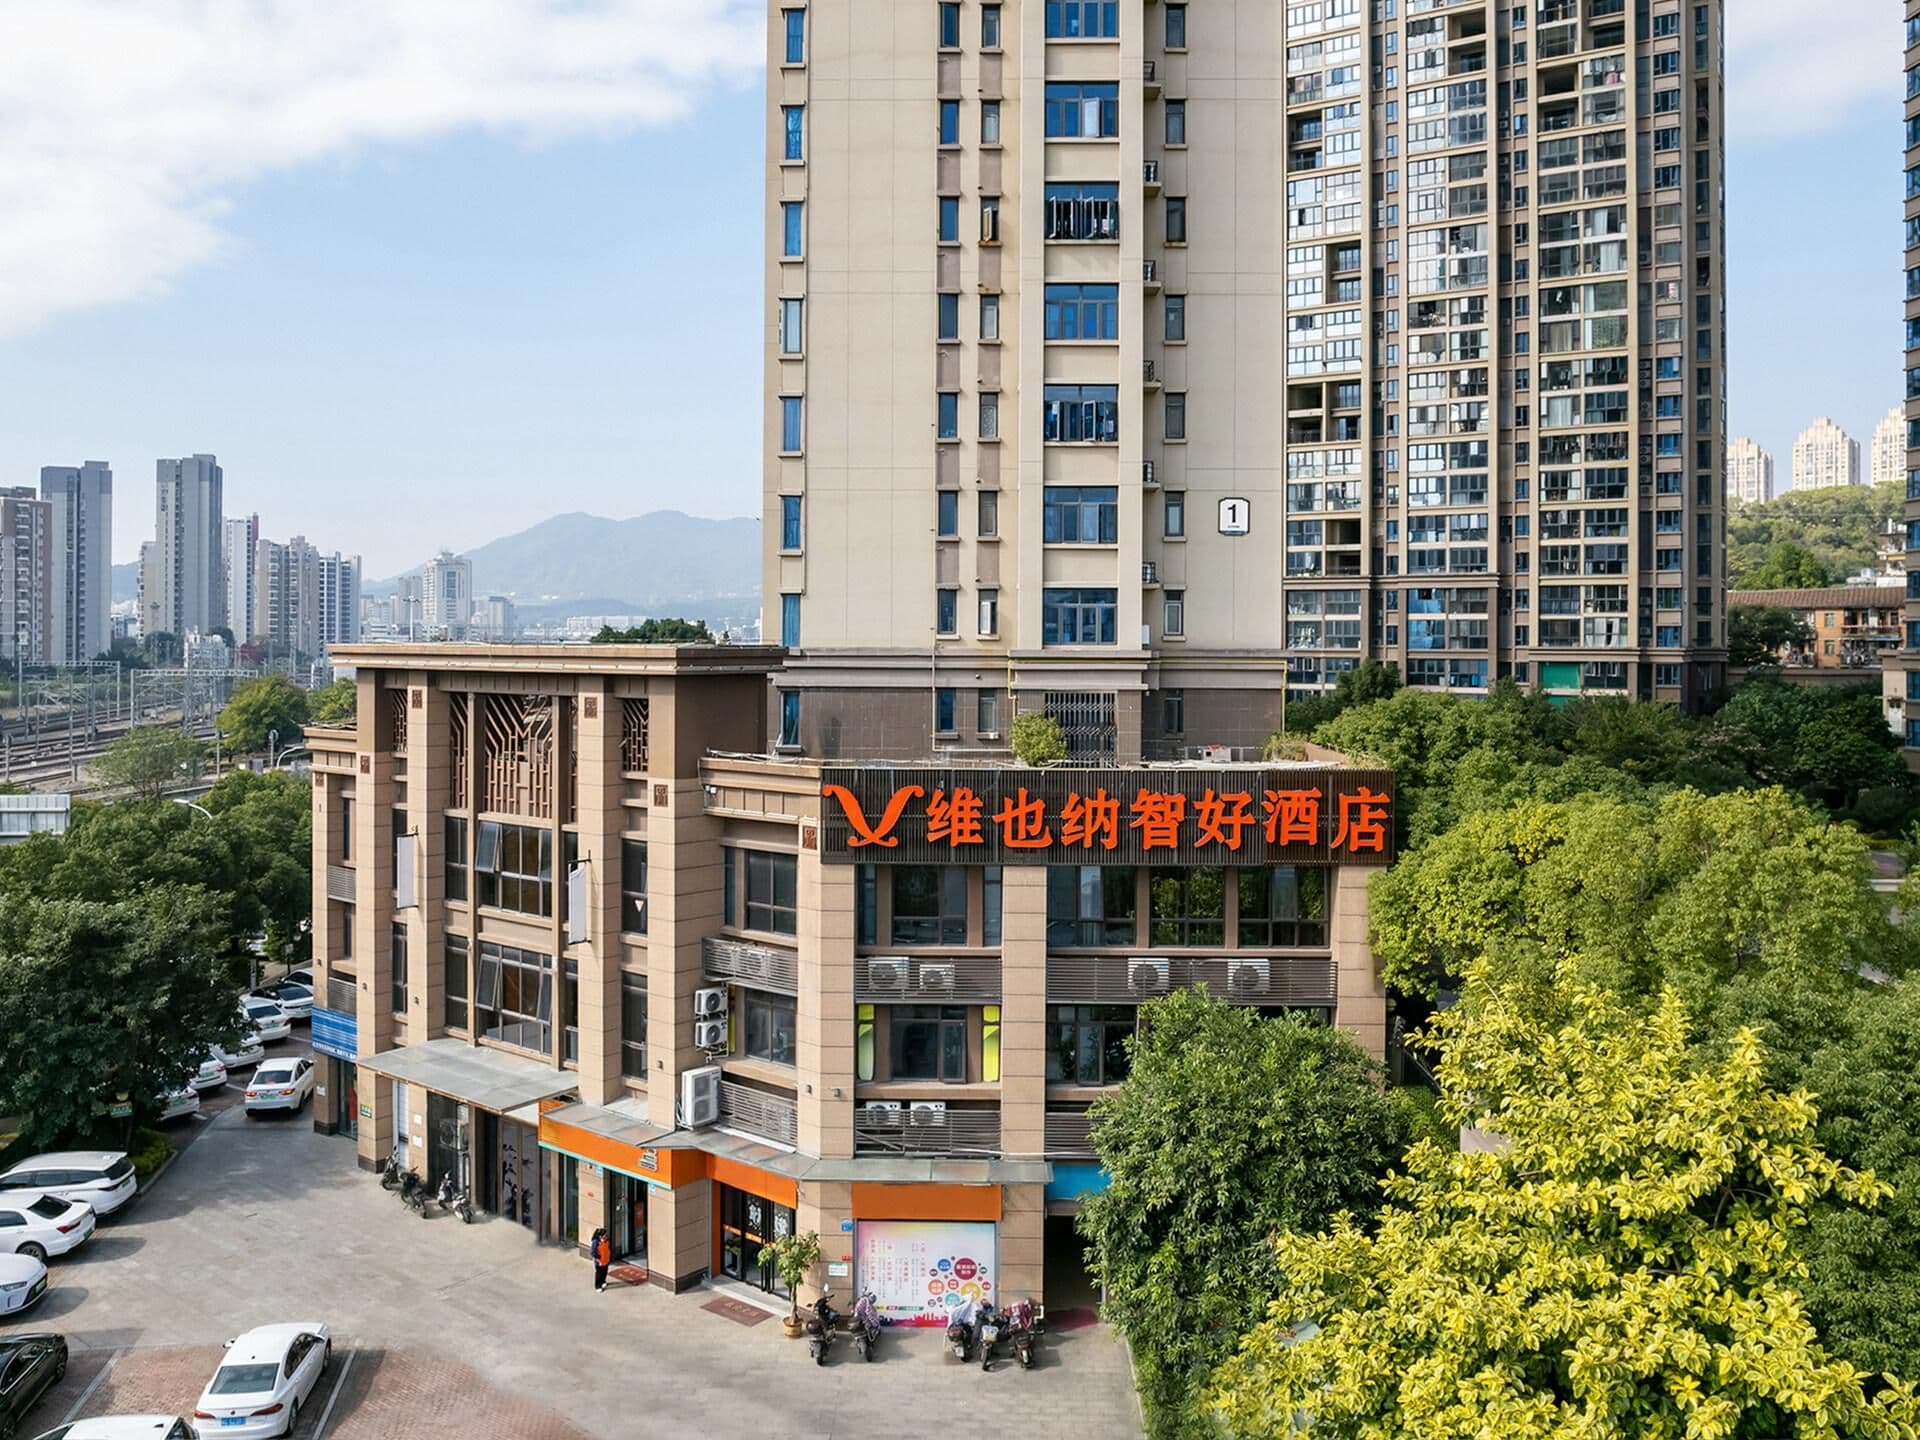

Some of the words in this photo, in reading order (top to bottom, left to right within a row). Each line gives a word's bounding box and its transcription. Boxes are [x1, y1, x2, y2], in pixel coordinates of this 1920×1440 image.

[1227, 504, 1236, 523] 1
[926, 786, 1391, 852] 维也纳智好酒店
